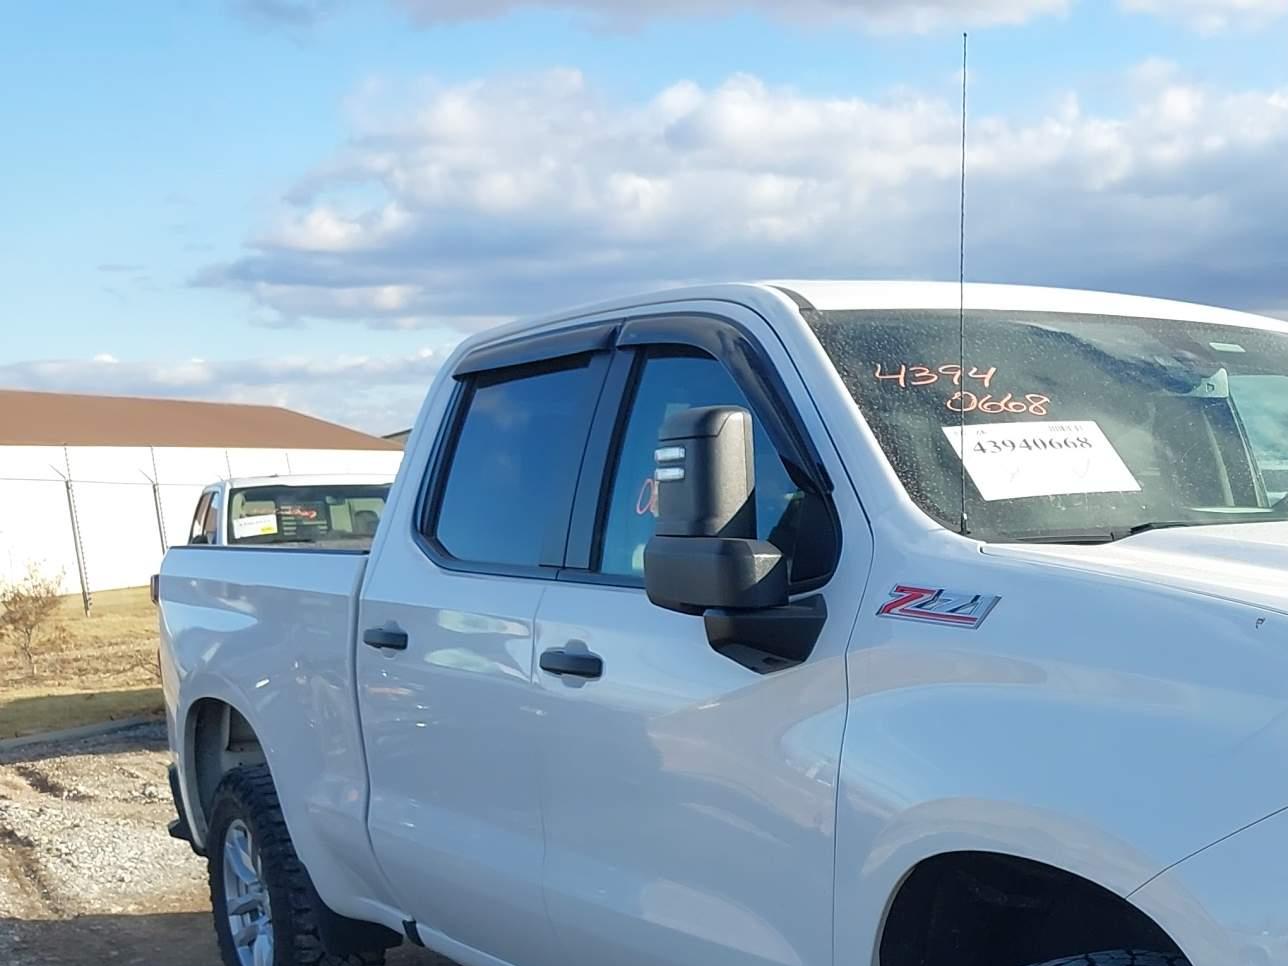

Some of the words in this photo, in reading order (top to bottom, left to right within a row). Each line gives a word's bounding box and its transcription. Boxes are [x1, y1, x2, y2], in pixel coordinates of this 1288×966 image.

[875, 363, 997, 389] 4394
[946, 391, 1051, 416] 0668
[972, 436, 1093, 455] 43940668
